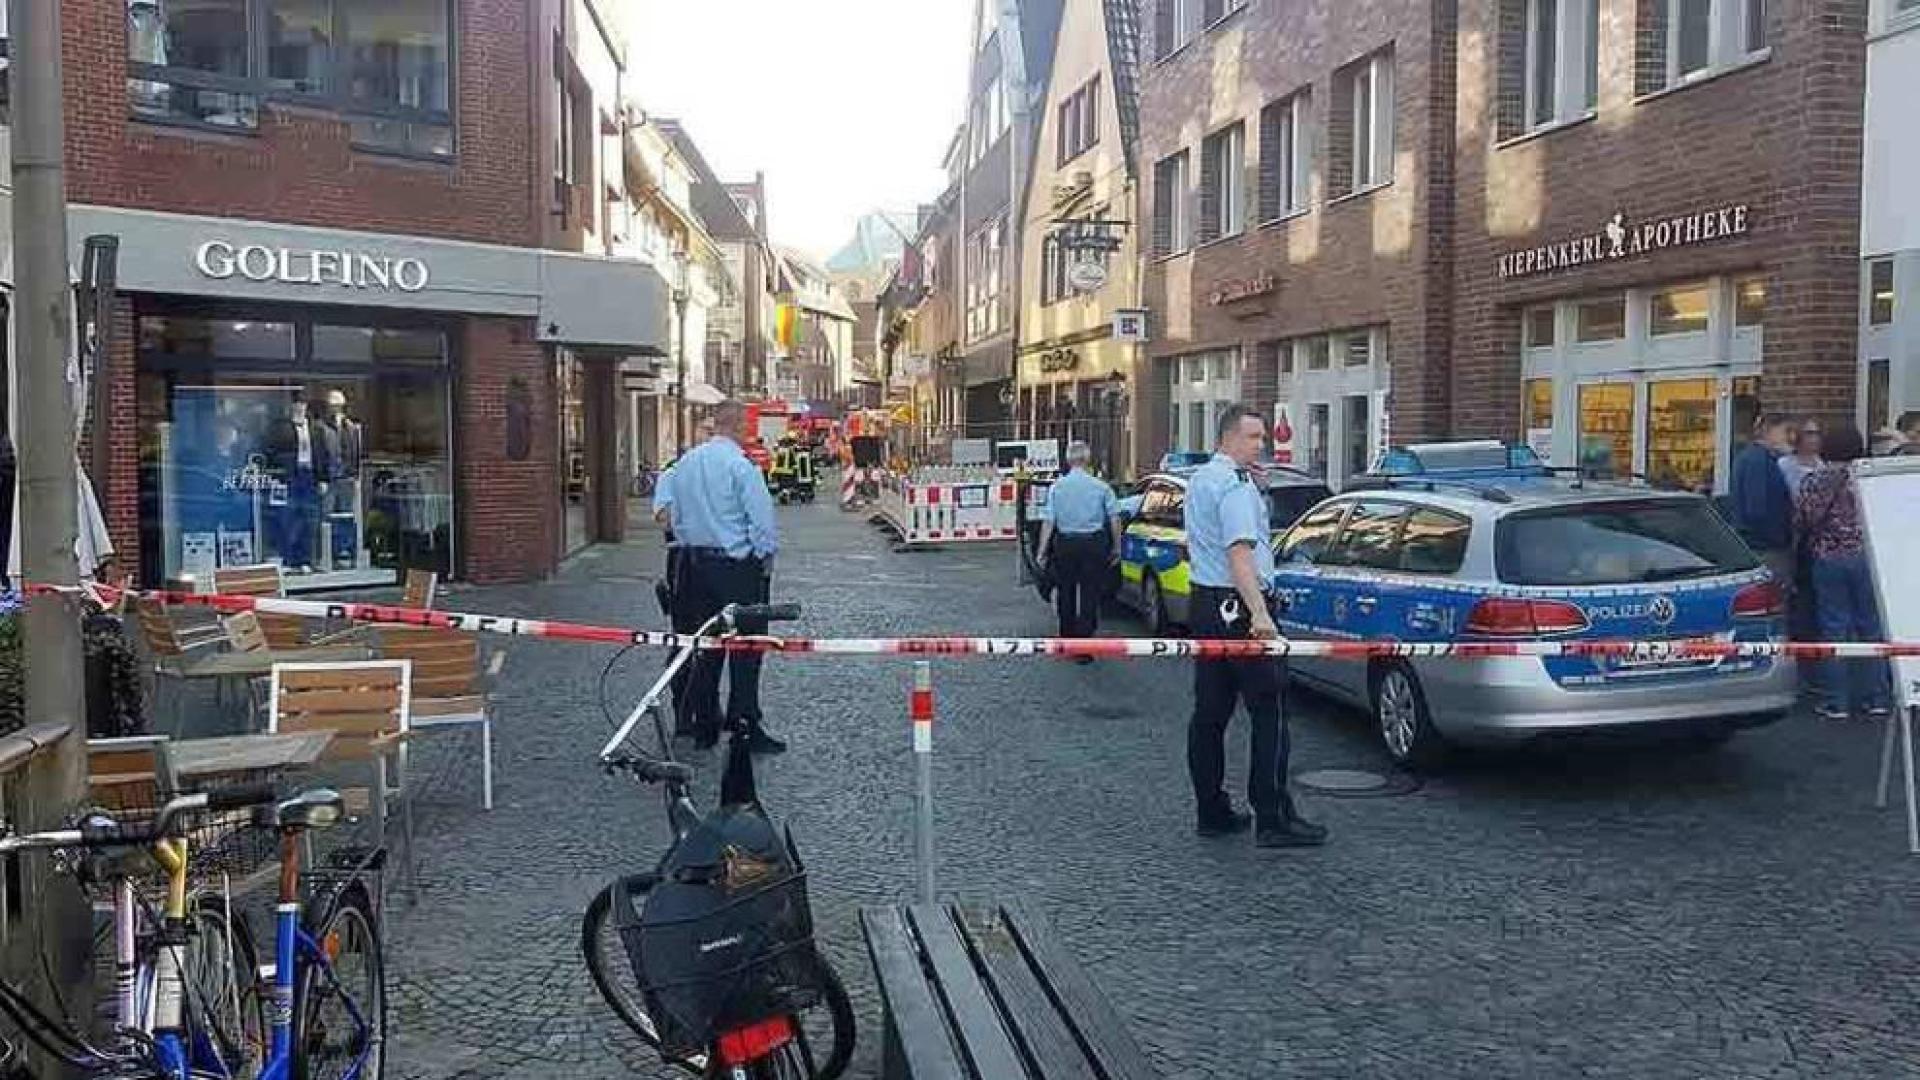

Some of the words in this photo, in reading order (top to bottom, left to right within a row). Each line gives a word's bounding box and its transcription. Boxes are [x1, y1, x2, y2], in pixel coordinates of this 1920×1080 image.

[196, 239, 430, 292] GOLFINO
[1498, 234, 1604, 278] KIEPENKERL
[1630, 204, 1748, 252] APOTHEKE
[1588, 603, 1650, 619] POLIZEI
